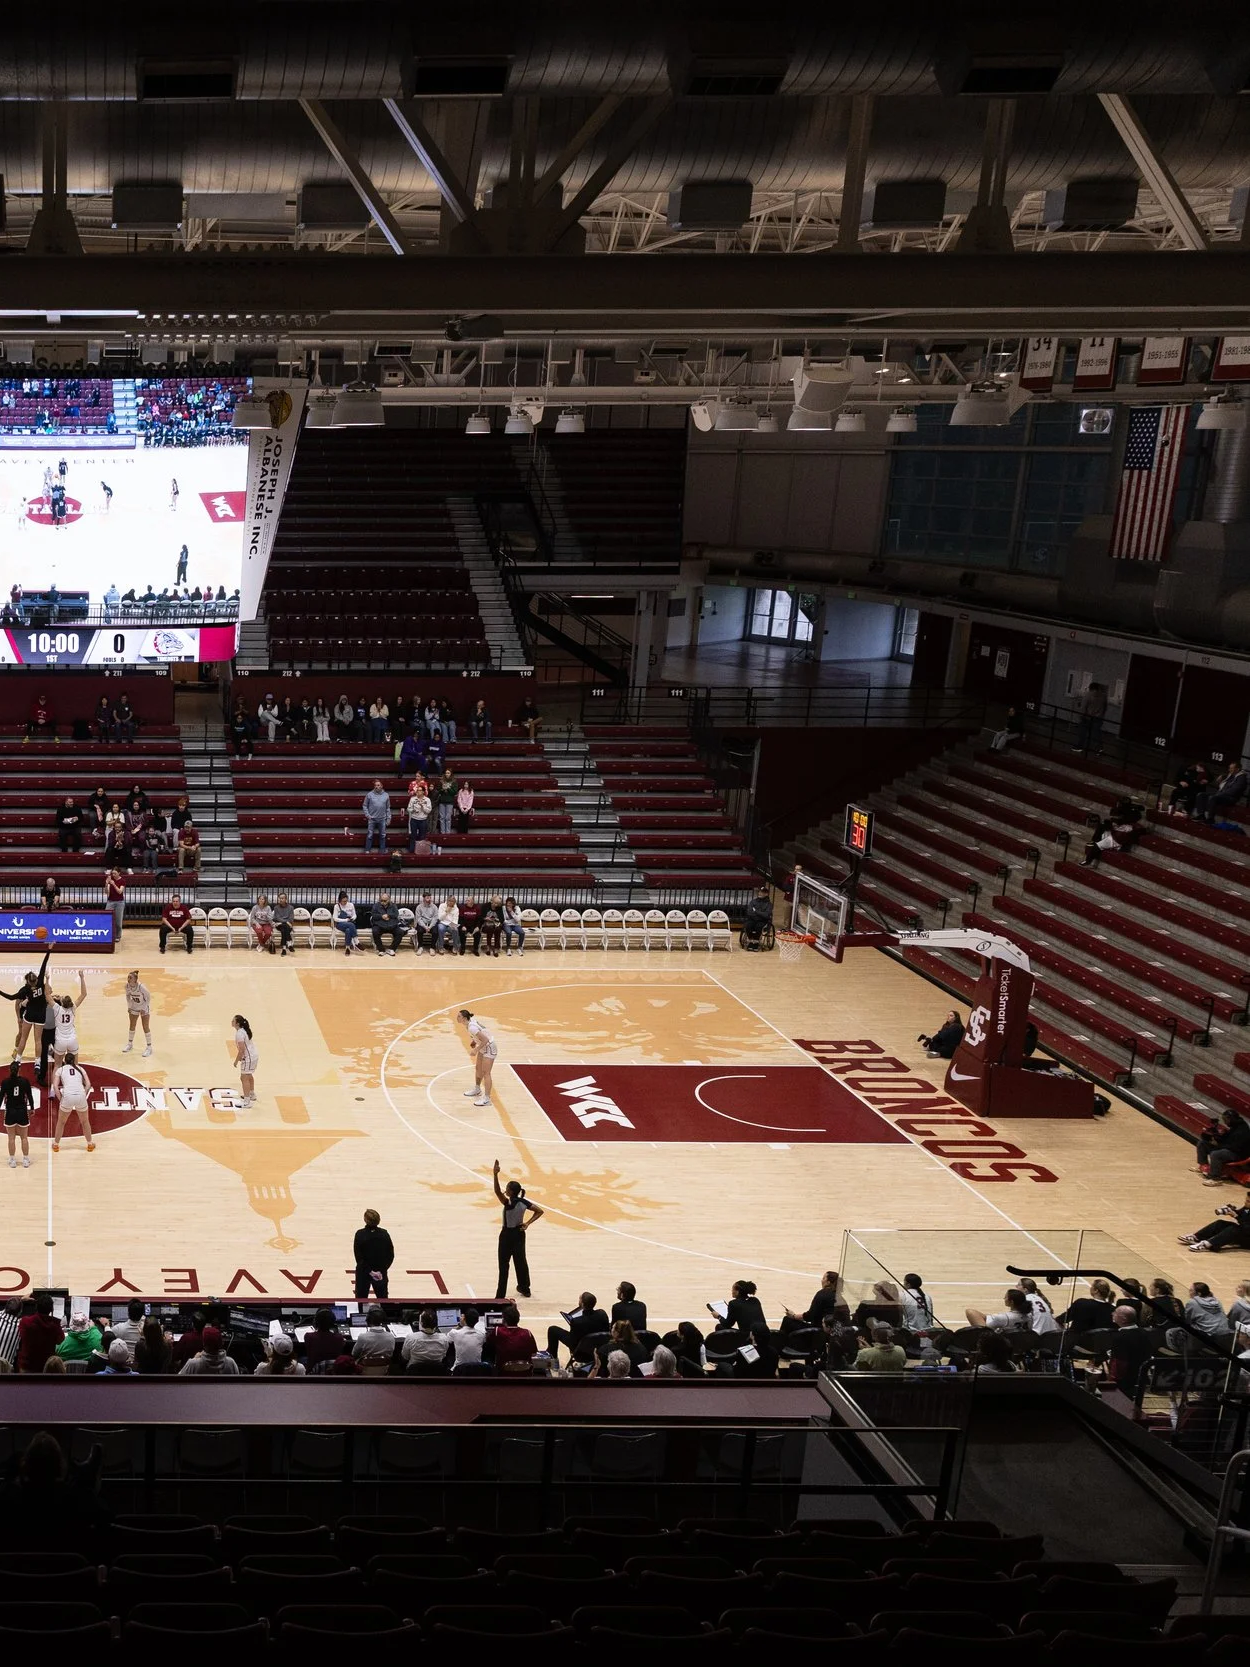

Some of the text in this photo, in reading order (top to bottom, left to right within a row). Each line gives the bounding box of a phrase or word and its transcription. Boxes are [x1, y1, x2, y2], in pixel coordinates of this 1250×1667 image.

[254, 435, 273, 520] ALBANESE
[267, 435, 283, 500] JOSEPH
[264, 506, 273, 519] J.
[248, 525, 261, 560] INC.
[27, 632, 79, 653] 10:00
[114, 633, 124, 653] 0
[1154, 737, 1166, 746] 112
[1211, 752, 1223, 762] 113
[851, 823, 865, 849] 30
[52, 928, 109, 936] UNIVERSITY
[33, 987, 42, 997] 20
[997, 968, 1012, 1035] TicketSmarter
[61, 1014, 71, 1023] 13
[13, 1086, 19, 1096] 8
[791, 1038, 1059, 1183] BRONCOS
[96, 1268, 451, 1294] LAVEY
[1035, 1300, 1046, 1313] 3
